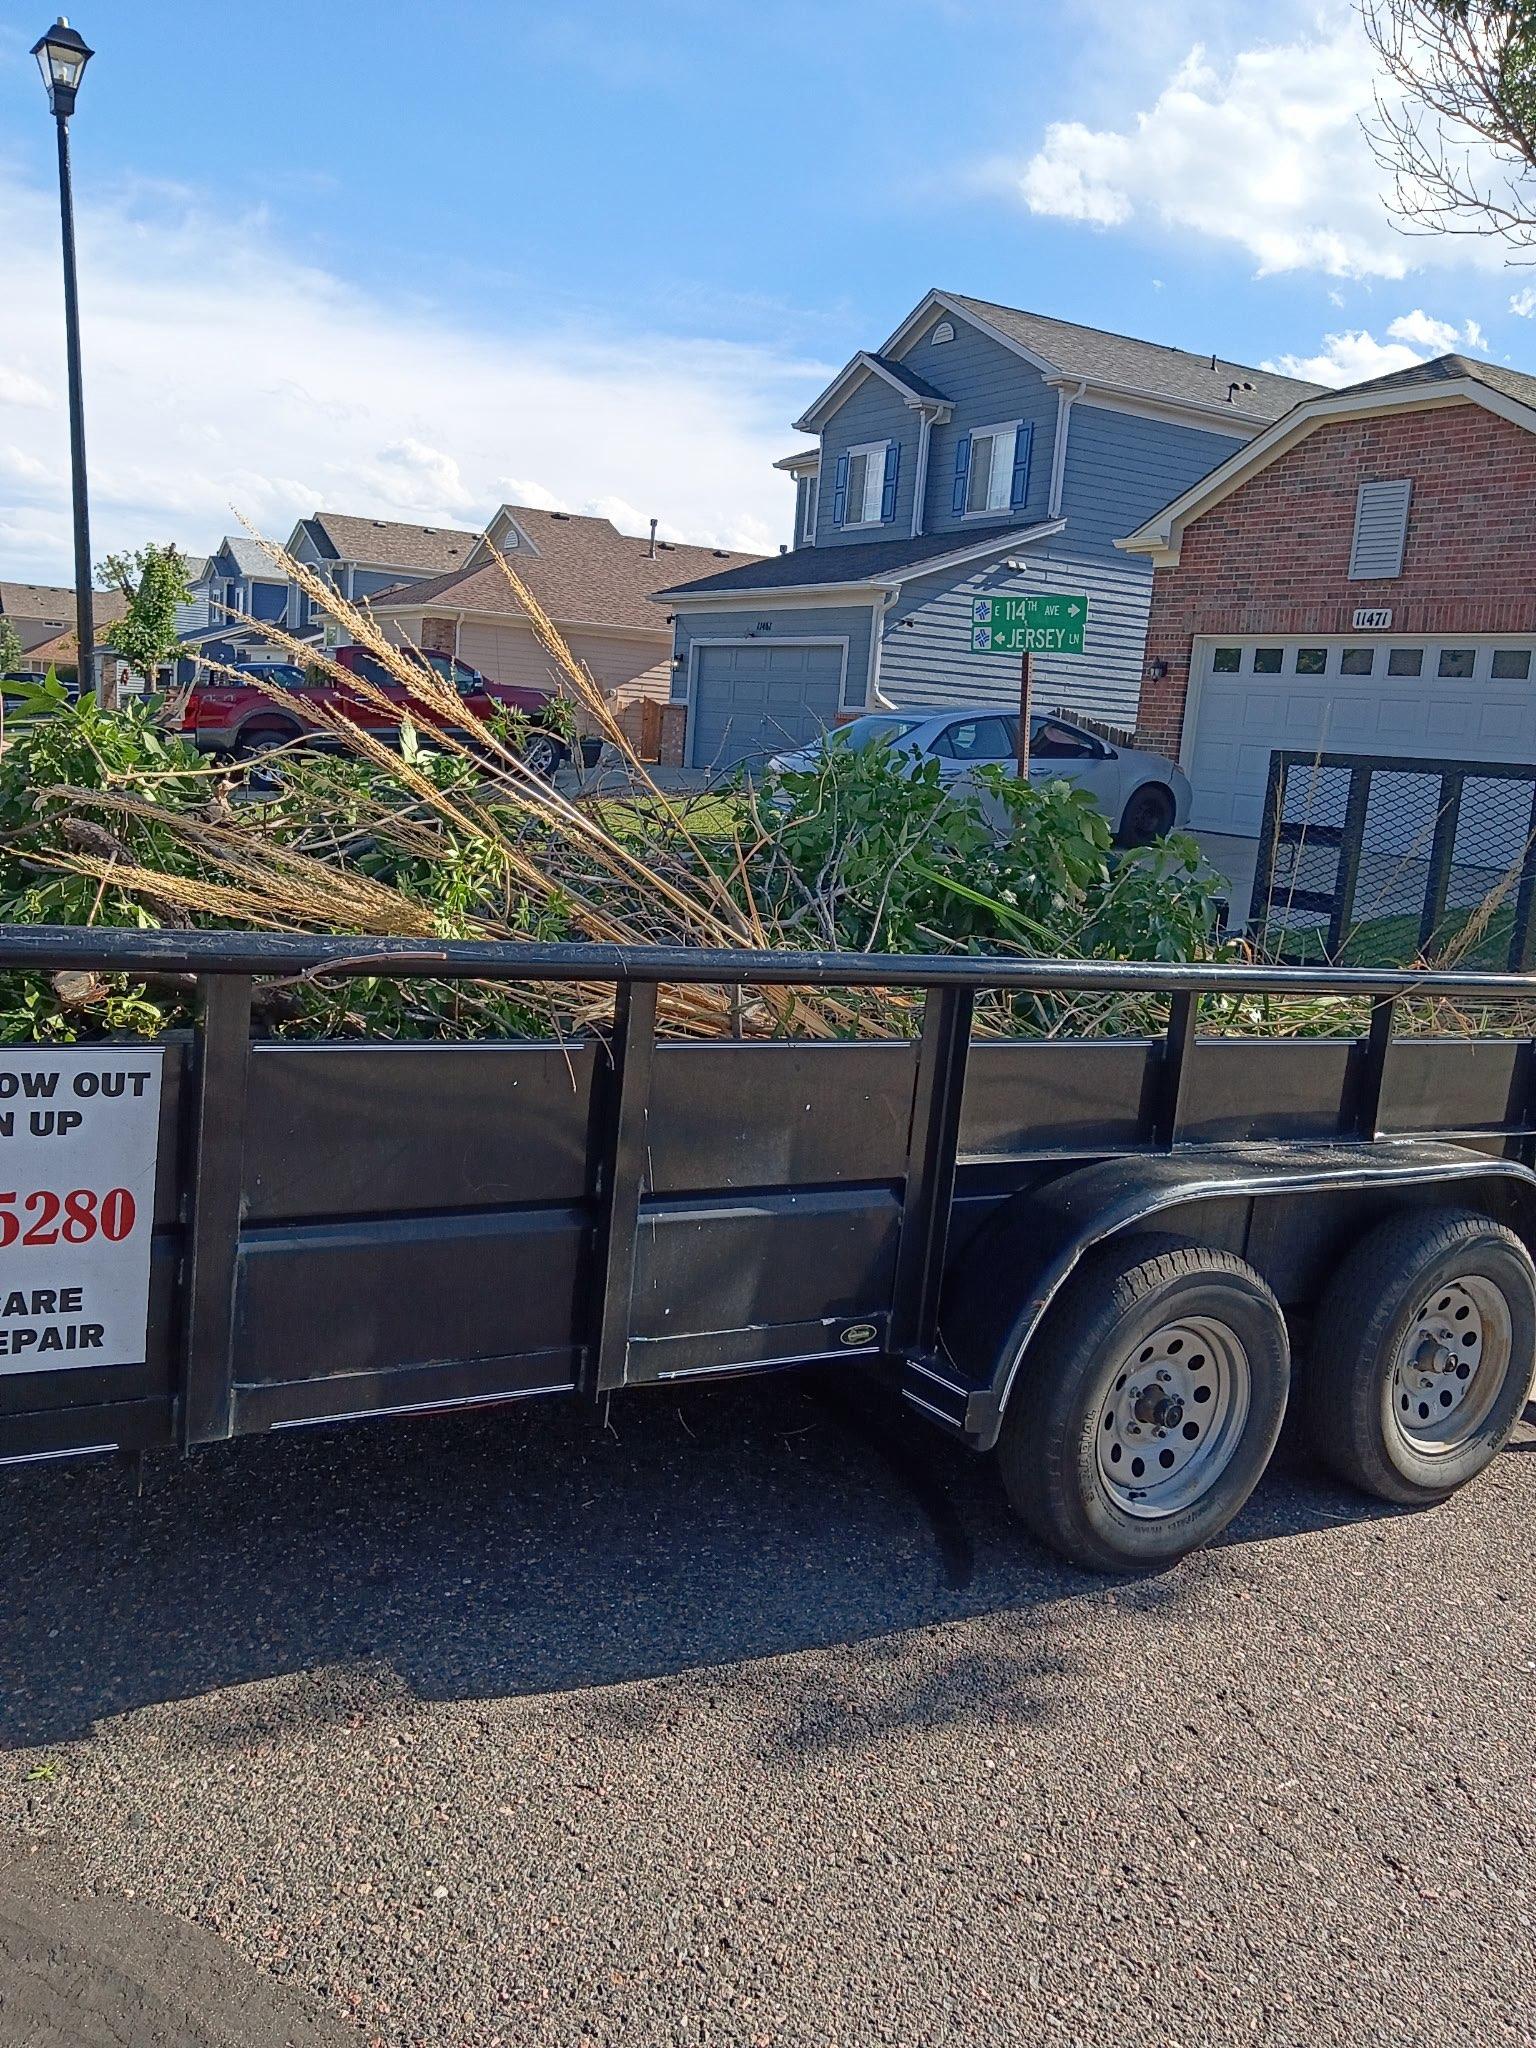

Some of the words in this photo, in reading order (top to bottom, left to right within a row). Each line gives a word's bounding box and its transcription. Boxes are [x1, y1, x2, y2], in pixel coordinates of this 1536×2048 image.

[994, 605, 1000, 616] E
[1044, 604, 1060, 616] AVE
[1356, 612, 1388, 627] 11471
[1006, 628, 1065, 649] JERSEY
[1069, 633, 1080, 645] LN
[0, 1072, 60, 1098] OW
[73, 1072, 151, 1097] OUT
[30, 1111, 83, 1136] UP
[0, 1188, 136, 1248] 5280
[0, 1287, 83, 1317] ARE
